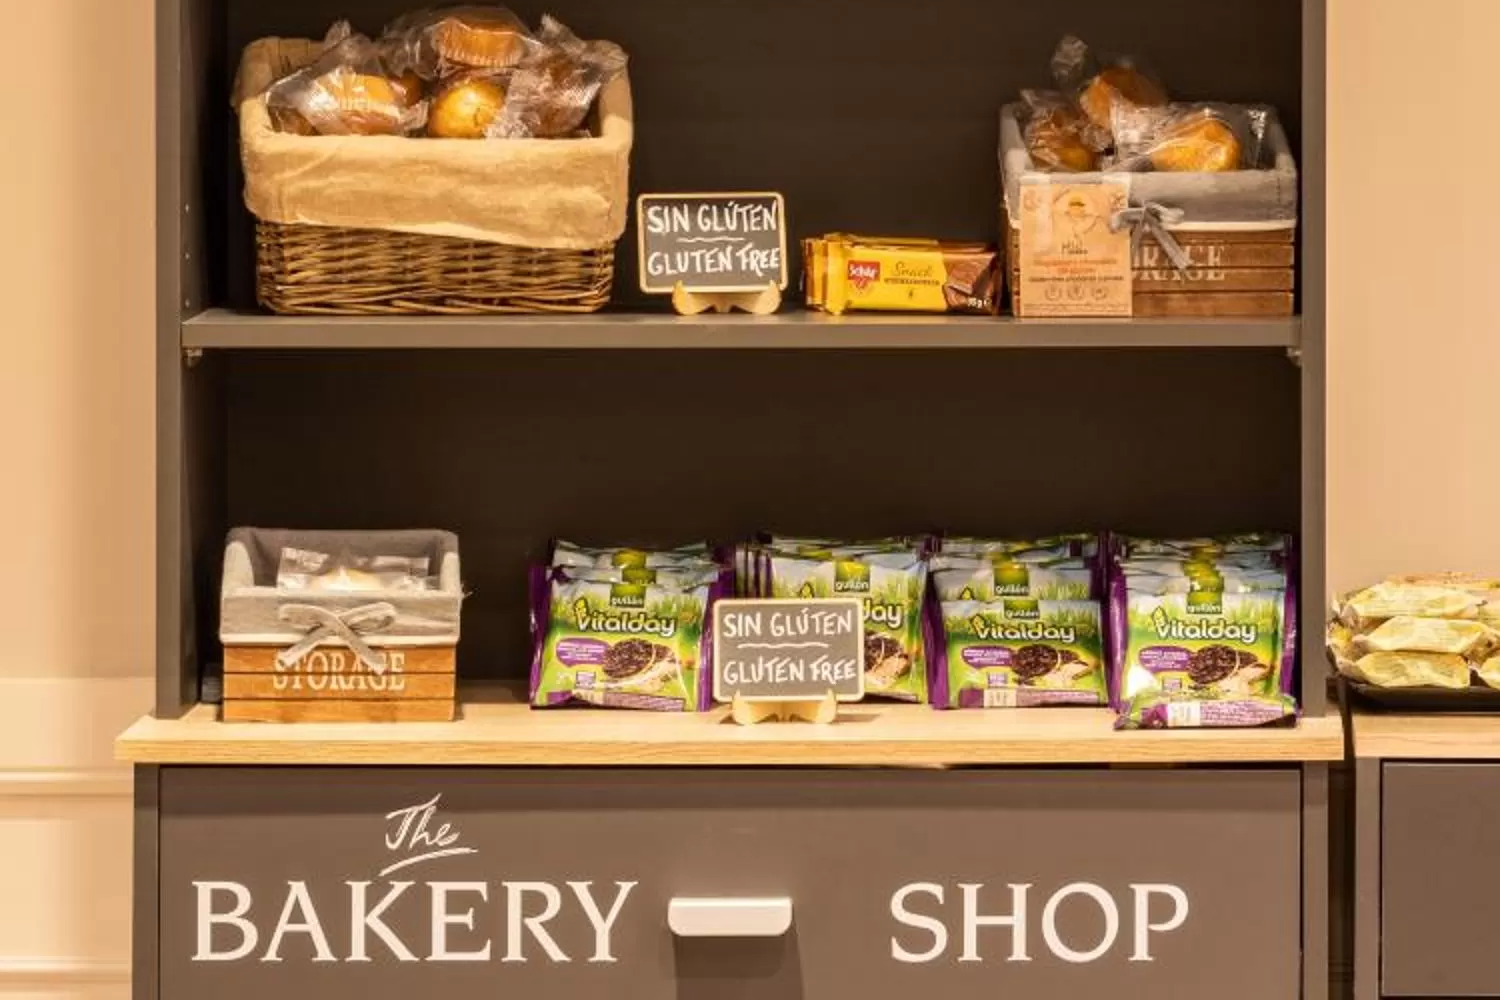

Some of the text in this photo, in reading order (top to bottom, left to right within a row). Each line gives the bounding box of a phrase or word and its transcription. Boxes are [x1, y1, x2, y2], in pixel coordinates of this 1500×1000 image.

[647, 199, 778, 234] SIN GLÚTEN
[647, 242, 781, 277] GLUTEN FREE
[722, 611, 762, 637] SIN
[769, 607, 853, 636] GLÚTEN
[723, 653, 858, 685] GLUTEN FREE
[384, 792, 462, 851] The
[191, 879, 1190, 963] BAKERY SHOP
